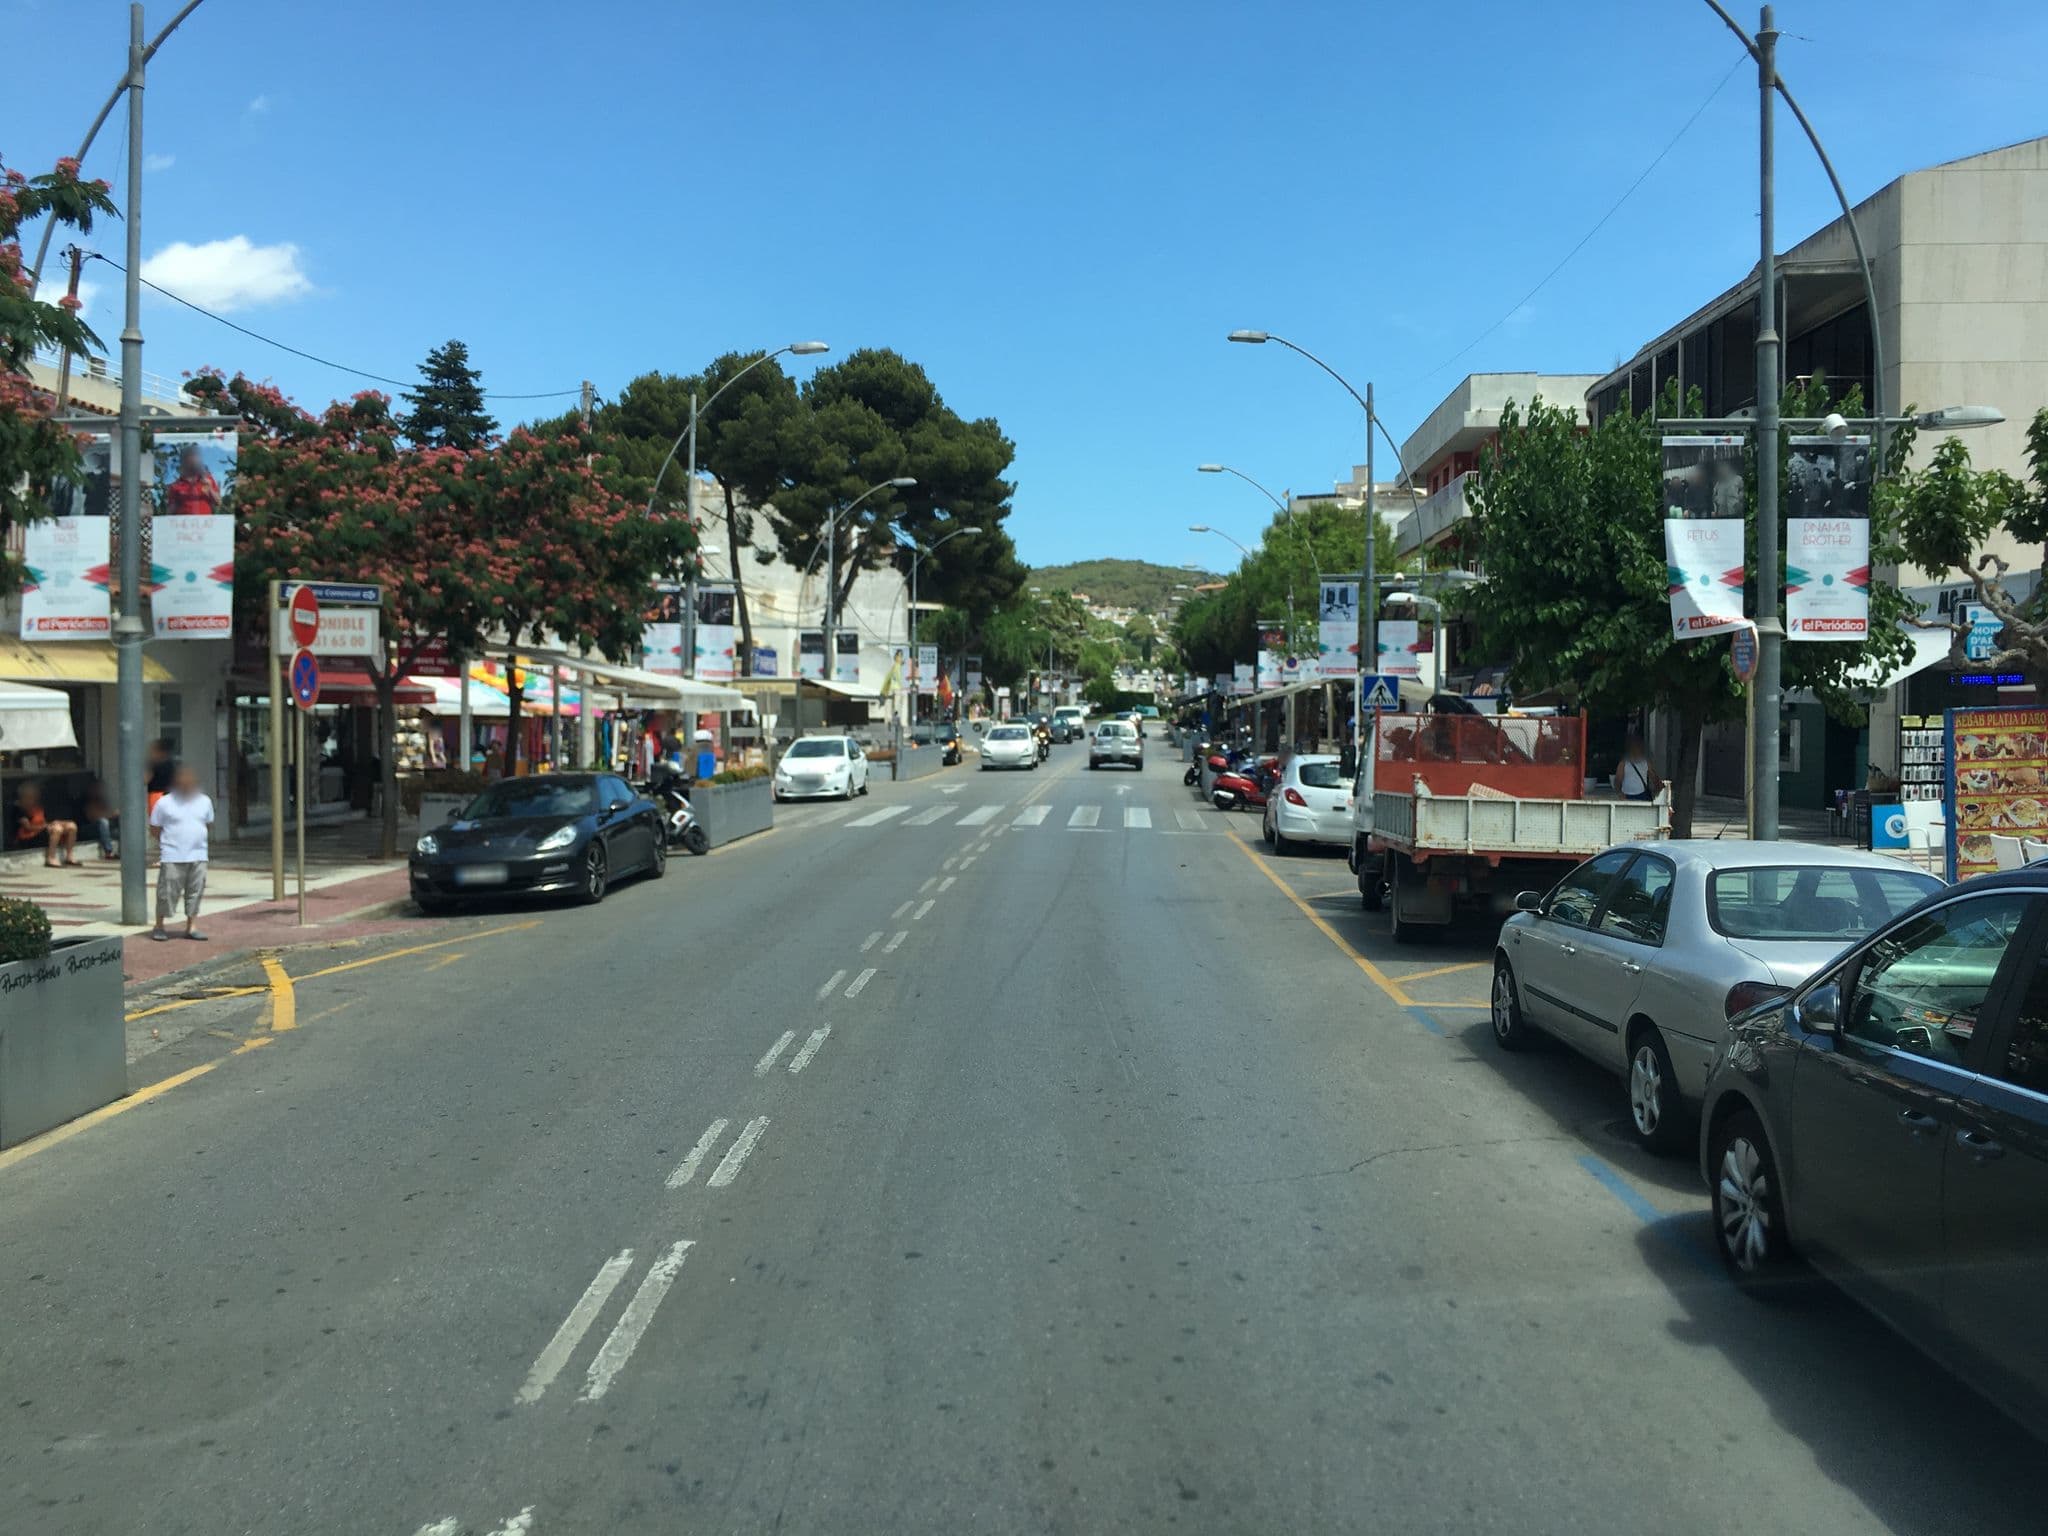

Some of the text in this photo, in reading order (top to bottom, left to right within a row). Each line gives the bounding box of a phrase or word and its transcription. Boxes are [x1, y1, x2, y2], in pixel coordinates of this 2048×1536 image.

[319, 617, 366, 631] ONIBLE
[1815, 618, 1865, 631] Periódico
[1970, 636, 1994, 646] D'AR
[1955, 714, 1985, 727] KEBAB
